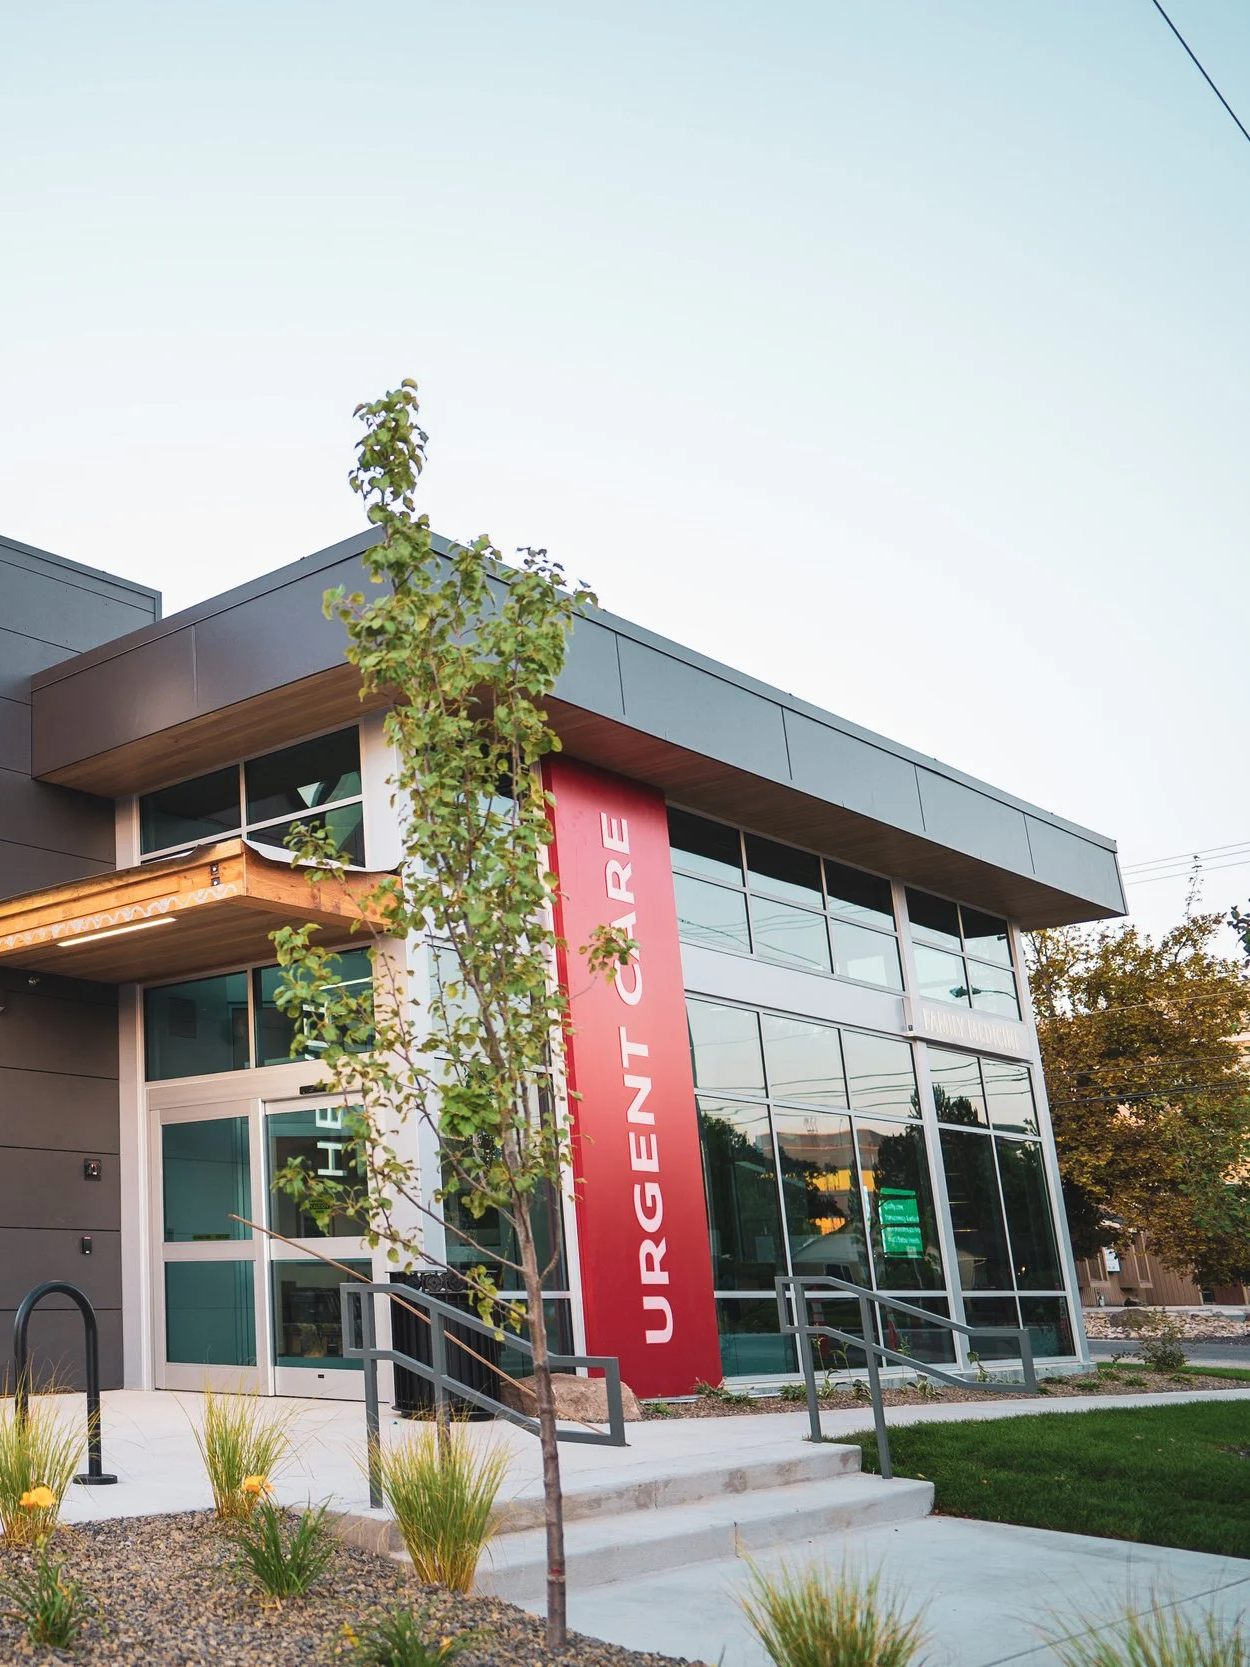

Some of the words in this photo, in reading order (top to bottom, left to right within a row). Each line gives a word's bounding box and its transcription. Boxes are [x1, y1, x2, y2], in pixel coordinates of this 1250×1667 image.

[600, 812, 643, 1007] CARE
[922, 1007, 964, 1038] FAMILY
[967, 1019, 1021, 1050] MEDICINE
[620, 1025, 674, 1344] URGENT
